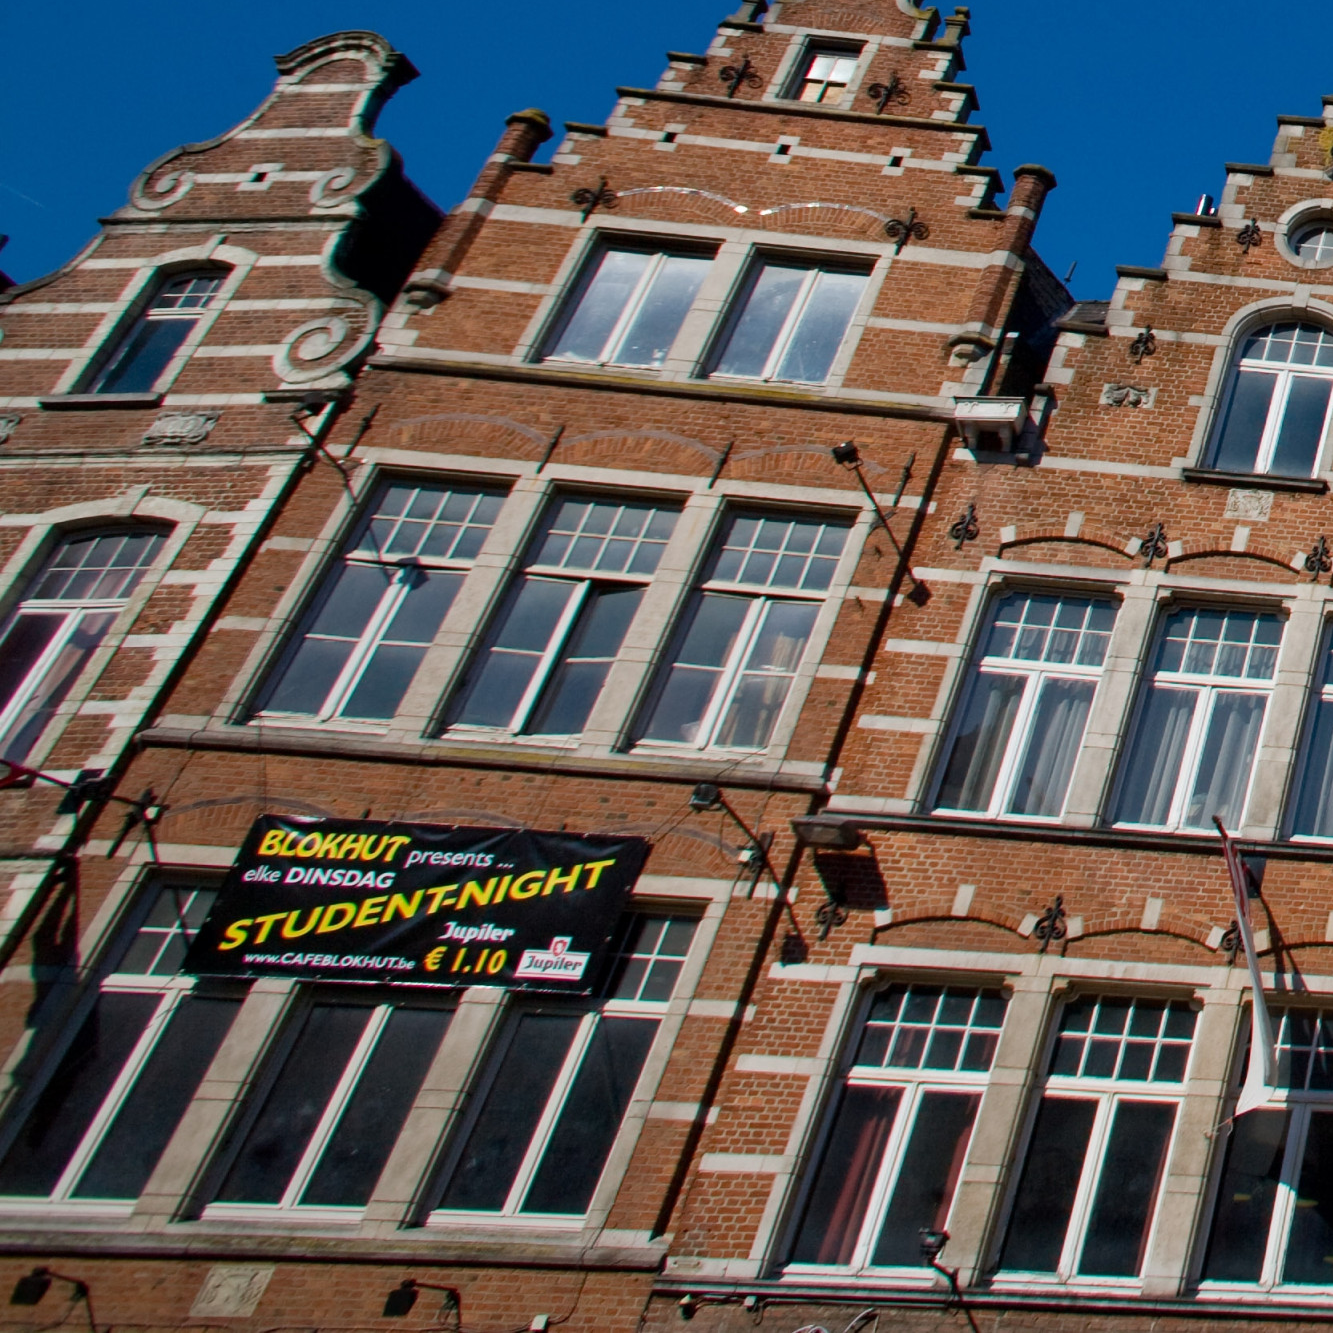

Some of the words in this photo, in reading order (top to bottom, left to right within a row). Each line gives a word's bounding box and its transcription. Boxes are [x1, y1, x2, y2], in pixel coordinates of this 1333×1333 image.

[258, 829, 411, 862] BLOKHUT
[403, 850, 495, 869] presents
[242, 865, 281, 883] elke
[284, 867, 396, 888] DINSDAG
[217, 858, 617, 951] STUDENT-NIGHT
[437, 921, 516, 944] Jupiler
[242, 952, 416, 970] www.CAFEBLOKHUT.be
[423, 946, 448, 972] €
[450, 947, 508, 975] 1.10
[523, 955, 583, 973] Jupiler
